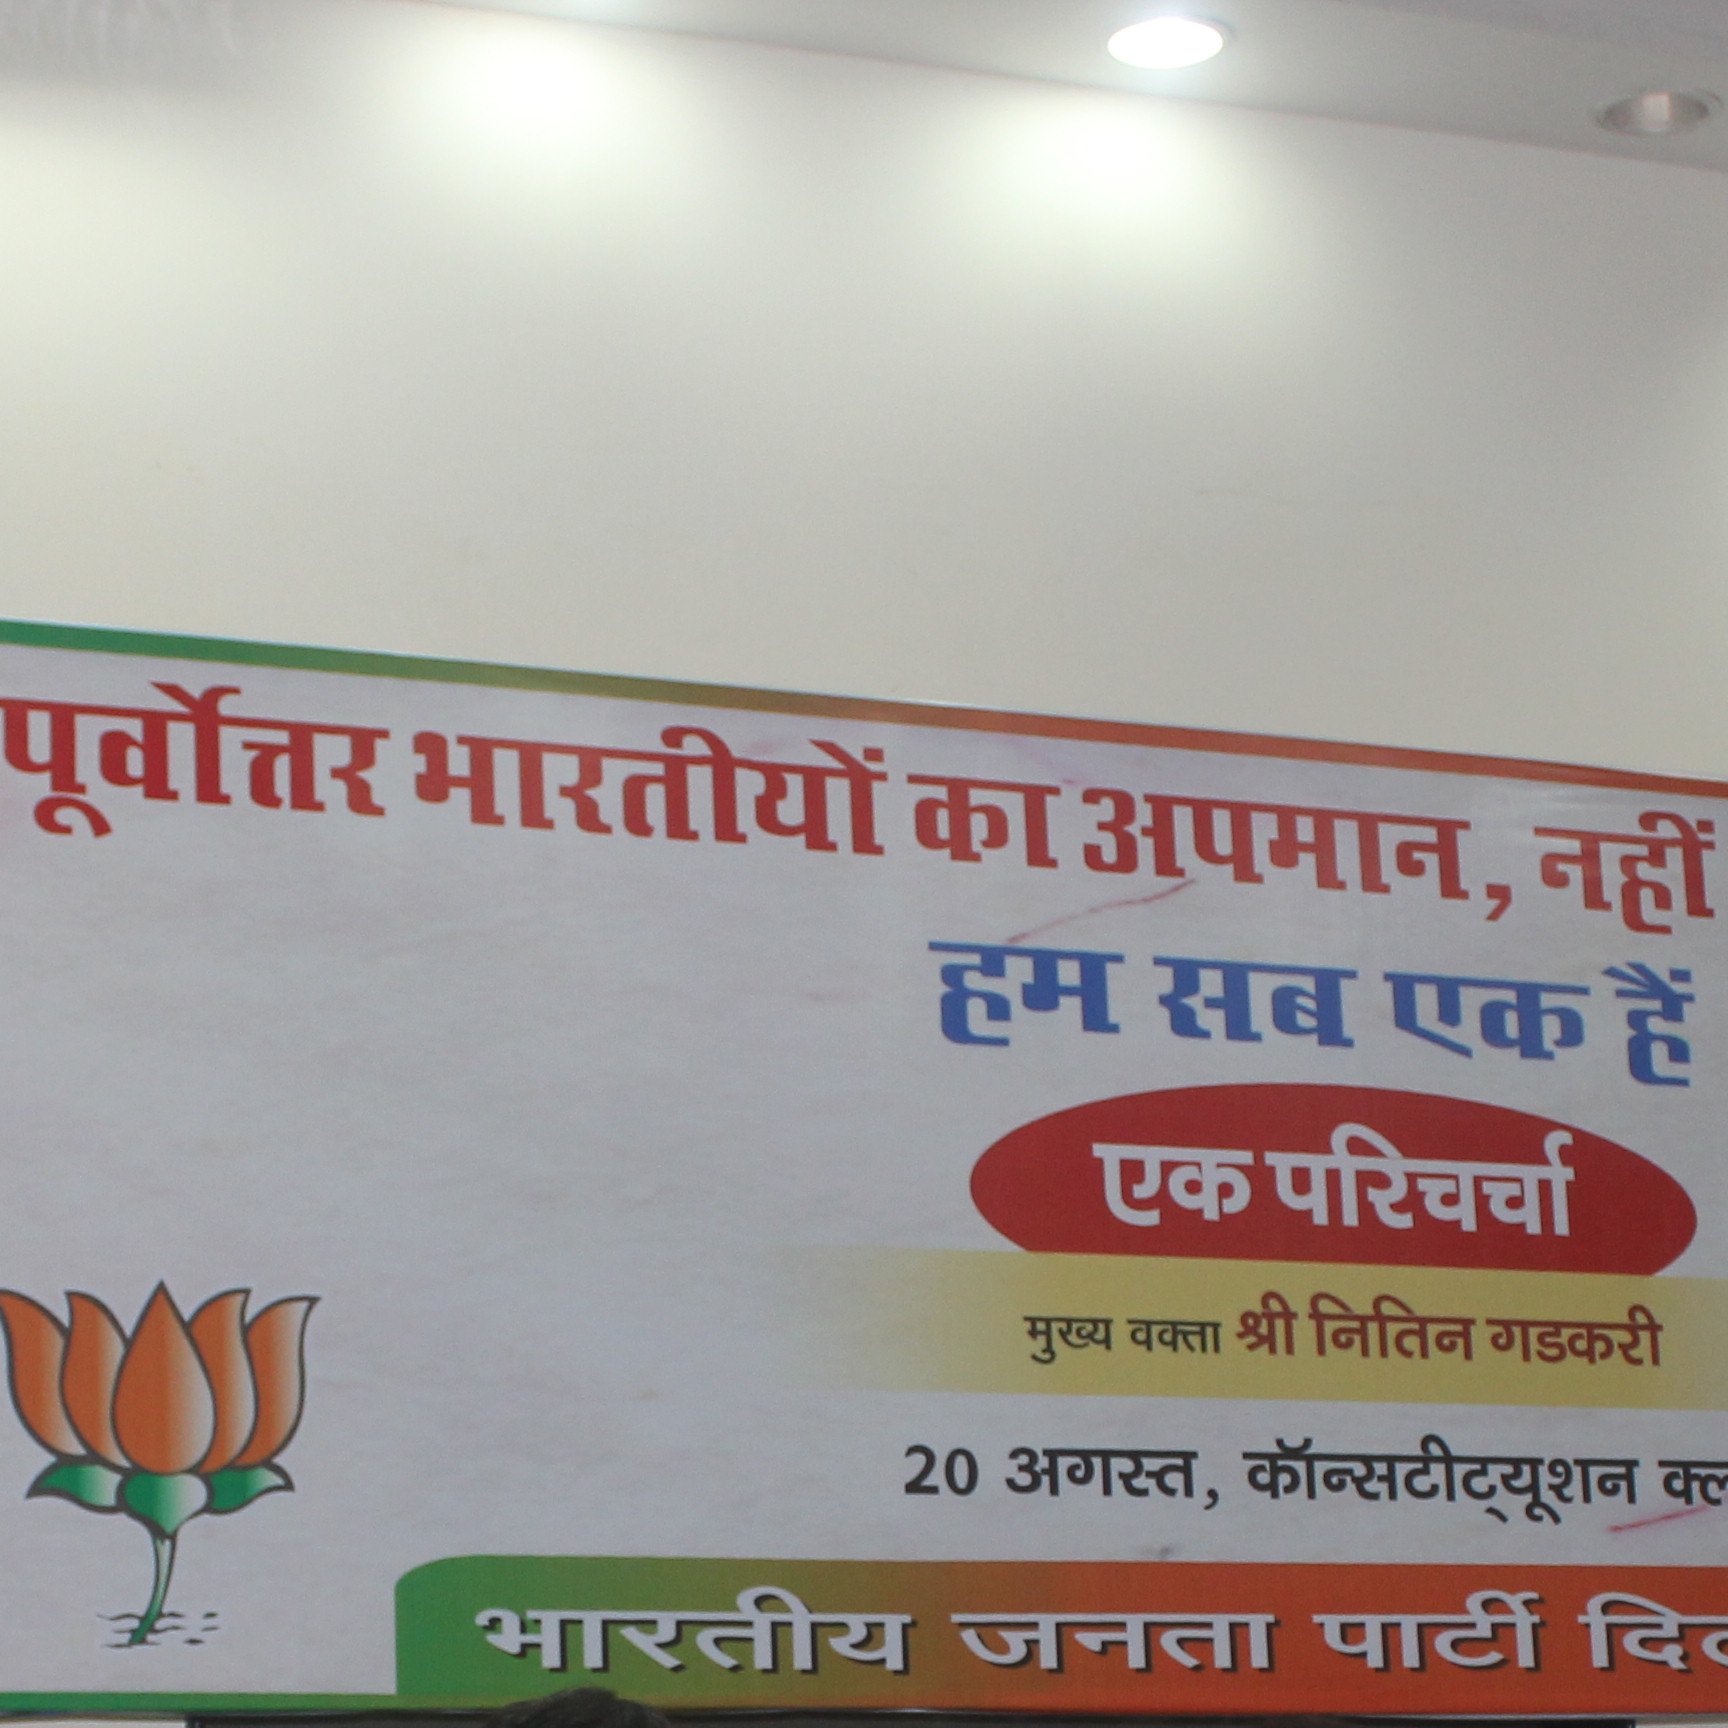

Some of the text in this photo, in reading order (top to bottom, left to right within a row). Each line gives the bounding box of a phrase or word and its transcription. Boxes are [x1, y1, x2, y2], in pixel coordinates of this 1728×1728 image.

[413, 725, 887, 855] भारतीयों
[907, 774, 1061, 869] का
[1081, 786, 1512, 921] अपमान,
[1533, 810, 1715, 935] नहीं
[928, 941, 1695, 1087] हम सब एक हैं
[1091, 1122, 1575, 1238] एक परिचर्चा
[1023, 1290, 1664, 1366] मुख्य वक्ता श्री नितिन गडकरी
[904, 1443, 979, 1496] 20
[1005, 1446, 1221, 1511] अगस्त,
[473, 1585, 913, 1672] भारतीय
[950, 1613, 1275, 1672] जनता
[1312, 1589, 1540, 1672] पार्टी
